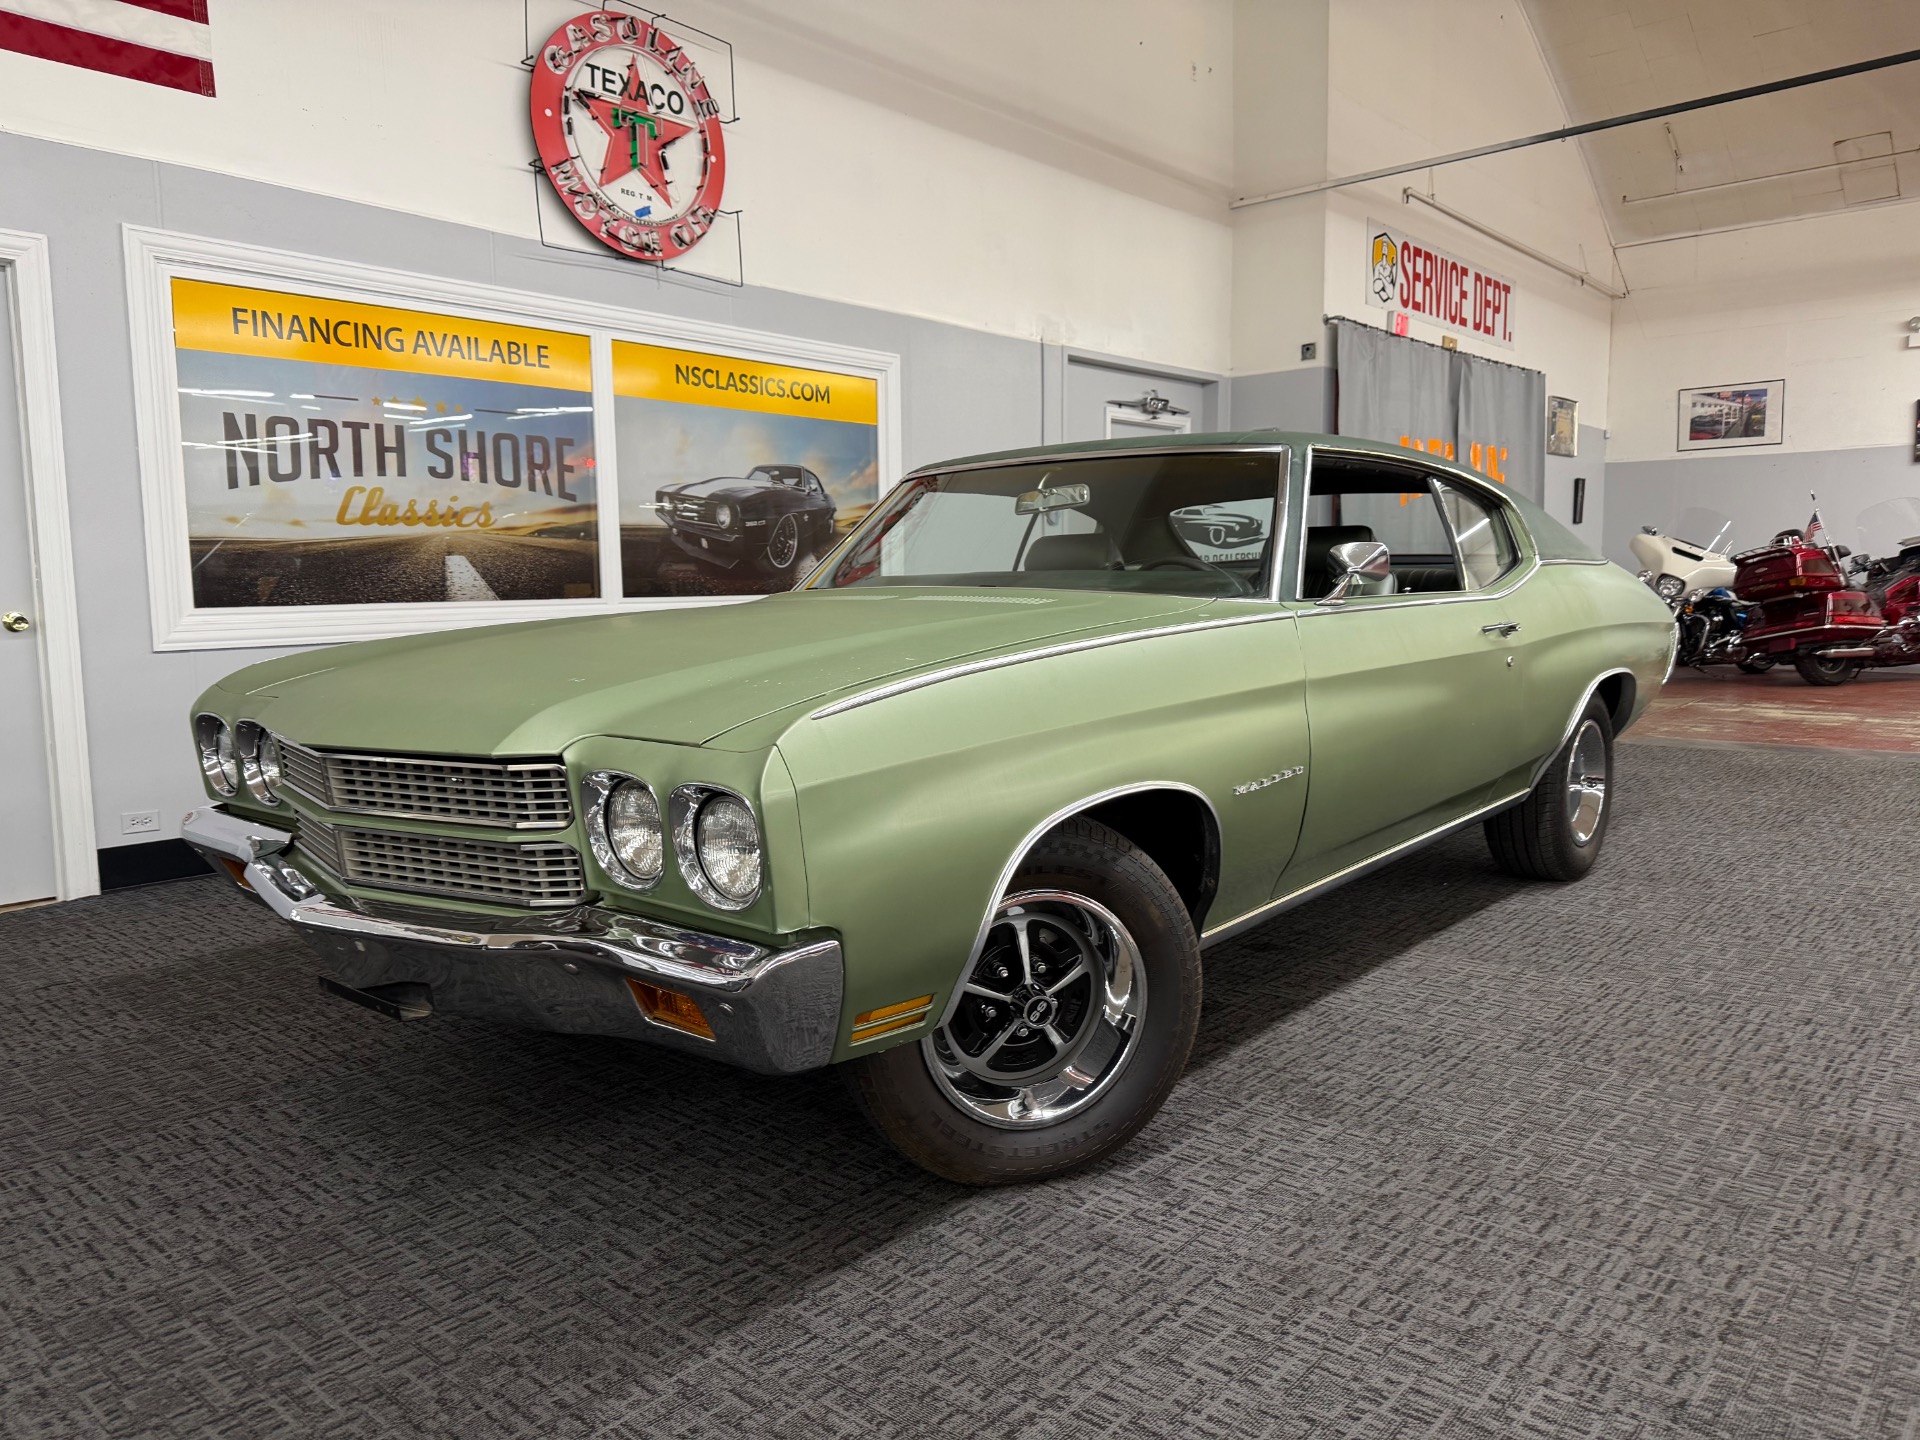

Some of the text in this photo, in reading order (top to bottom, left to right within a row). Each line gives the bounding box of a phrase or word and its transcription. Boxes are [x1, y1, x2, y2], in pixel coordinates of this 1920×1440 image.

[585, 63, 684, 115] TEXACO
[1399, 240, 1512, 342] SERVICE DEPT.
[231, 307, 550, 369] FINANCING AVAILABLE
[675, 363, 831, 404] NSCLASSICS.COM
[223, 411, 578, 502] NORTH SHORE
[336, 485, 499, 528] Classics
[1030, 1001, 1048, 1022] SS
